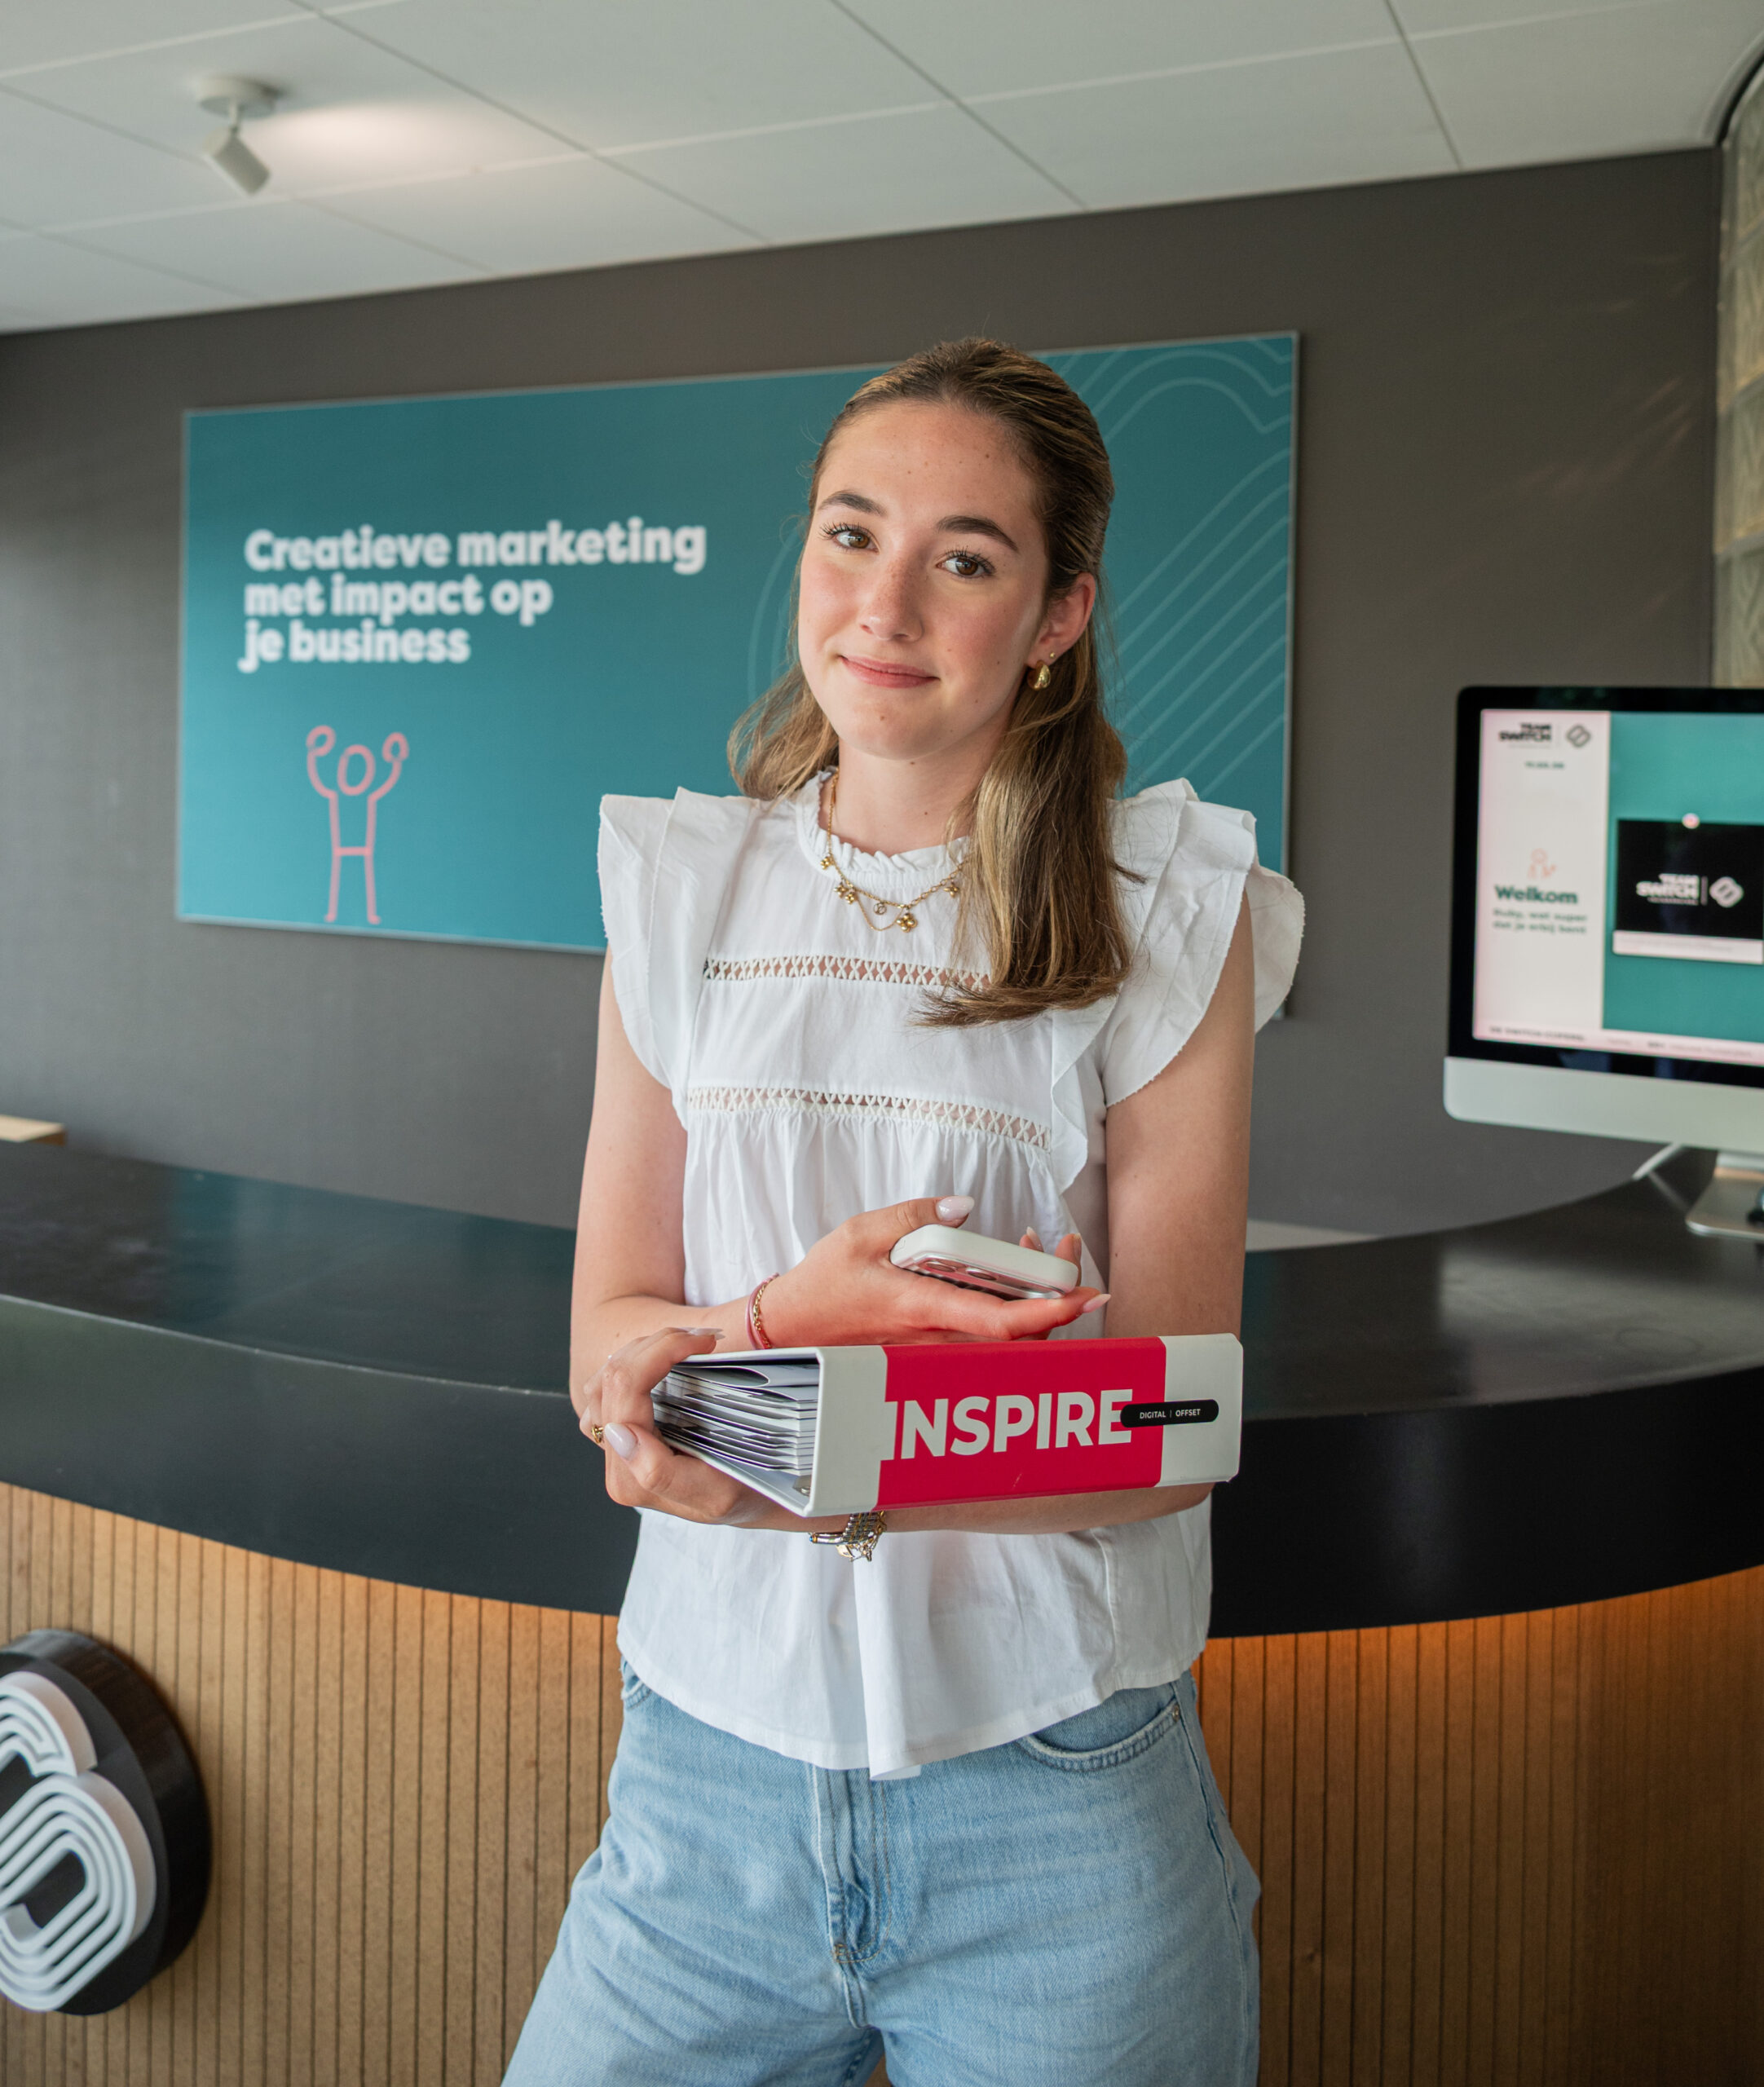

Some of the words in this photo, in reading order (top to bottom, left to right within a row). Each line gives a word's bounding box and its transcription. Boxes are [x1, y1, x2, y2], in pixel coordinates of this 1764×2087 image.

[245, 524, 451, 571] Creatieve
[457, 517, 707, 575] marketing
[245, 576, 325, 616] met
[331, 572, 484, 626] impact
[490, 579, 553, 626] op
[237, 619, 284, 673] je
[289, 619, 470, 663] business
[1499, 730, 1551, 742] SWITCH
[1494, 885, 1578, 904] Welkom
[883, 1388, 1133, 1461] INSPIRE
[1139, 1410, 1166, 1419] DIGITAL
[1175, 1408, 1202, 1418] OFFSET
